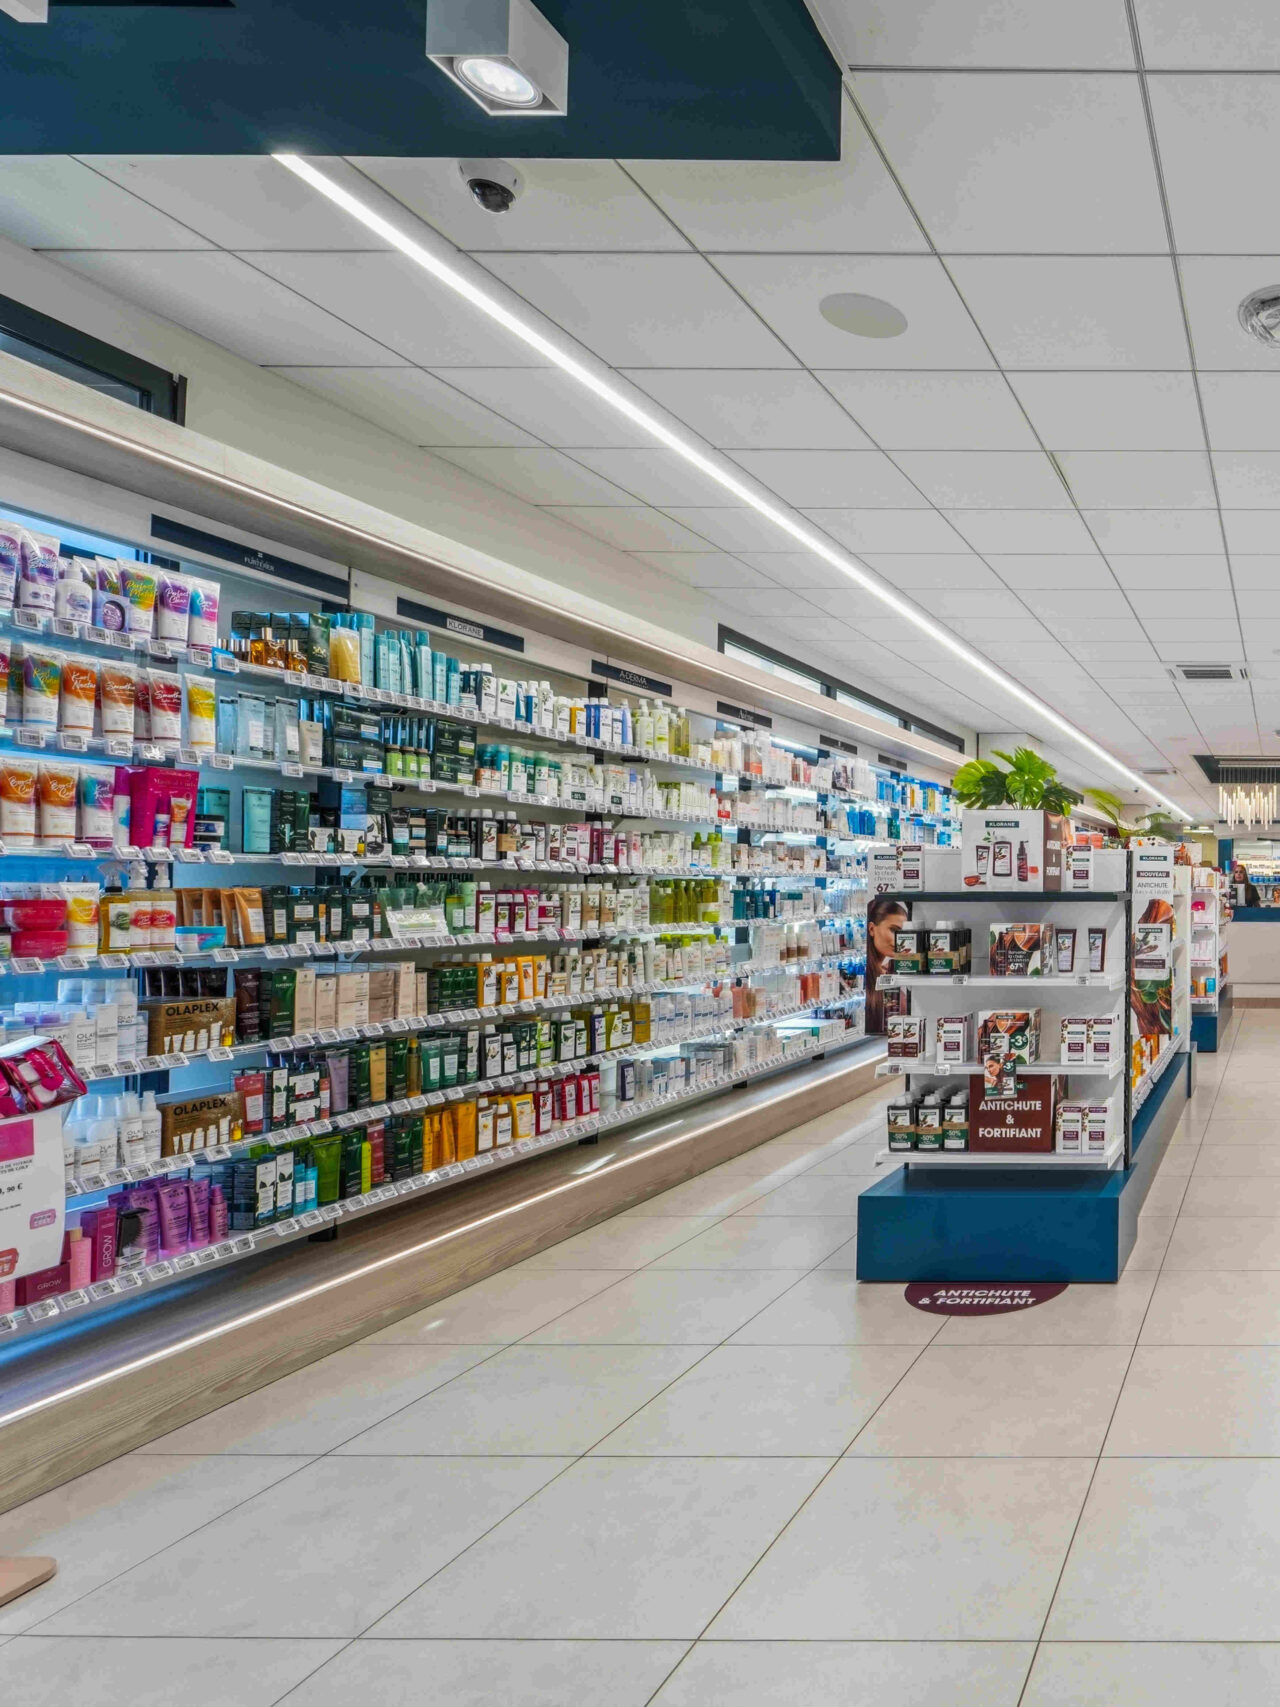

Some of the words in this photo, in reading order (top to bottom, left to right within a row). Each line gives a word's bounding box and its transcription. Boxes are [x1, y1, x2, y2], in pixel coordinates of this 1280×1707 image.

[448, 619, 484, 638] KLORANE
[874, 883, 896, 892] -67%
[166, 1002, 219, 1017] OLAPLEX
[173, 1097, 228, 1116] OLAPLEX
[978, 1100, 1042, 1111] ANTICHUTE
[1006, 1114, 1014, 1124] &
[978, 1128, 1042, 1138] FORTIFIANT
[102, 1235, 112, 1268] GROW
[37, 1278, 62, 1290] GROW
